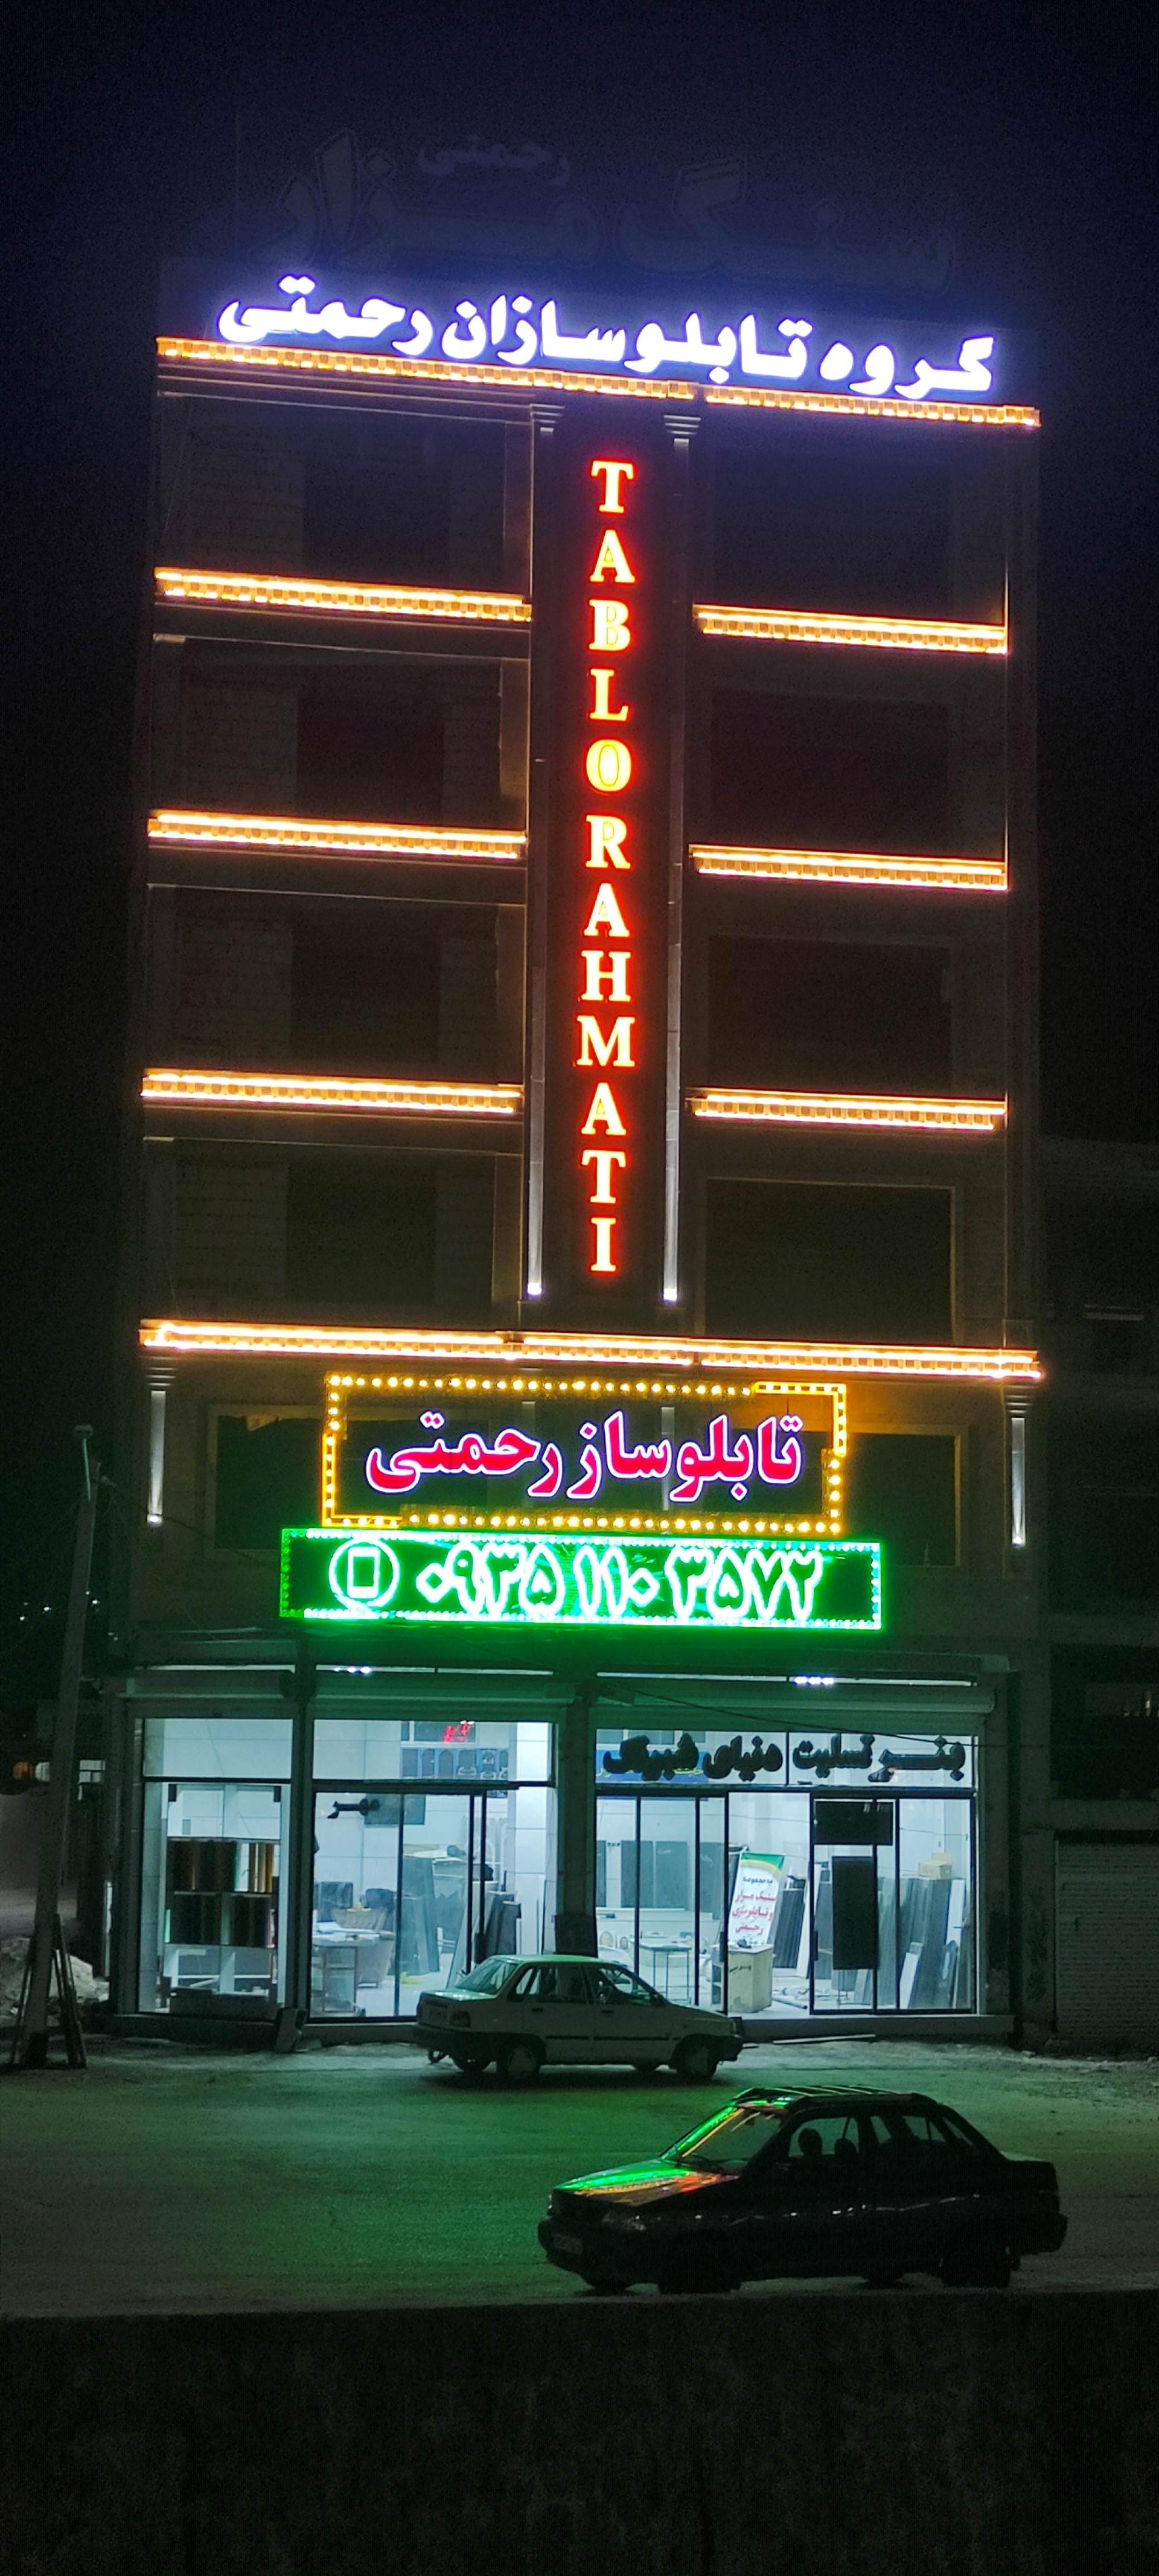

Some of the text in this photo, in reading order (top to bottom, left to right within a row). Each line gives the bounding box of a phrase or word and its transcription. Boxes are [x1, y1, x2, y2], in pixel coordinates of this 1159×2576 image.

[218, 274, 434, 357] رحمتی
[820, 335, 995, 400] گروه
[365, 1411, 563, 1499] رحمتی
[702, 1735, 784, 1781] دنیای
[793, 1733, 875, 1778] تسلیت
[868, 1735, 966, 1782] بنر
